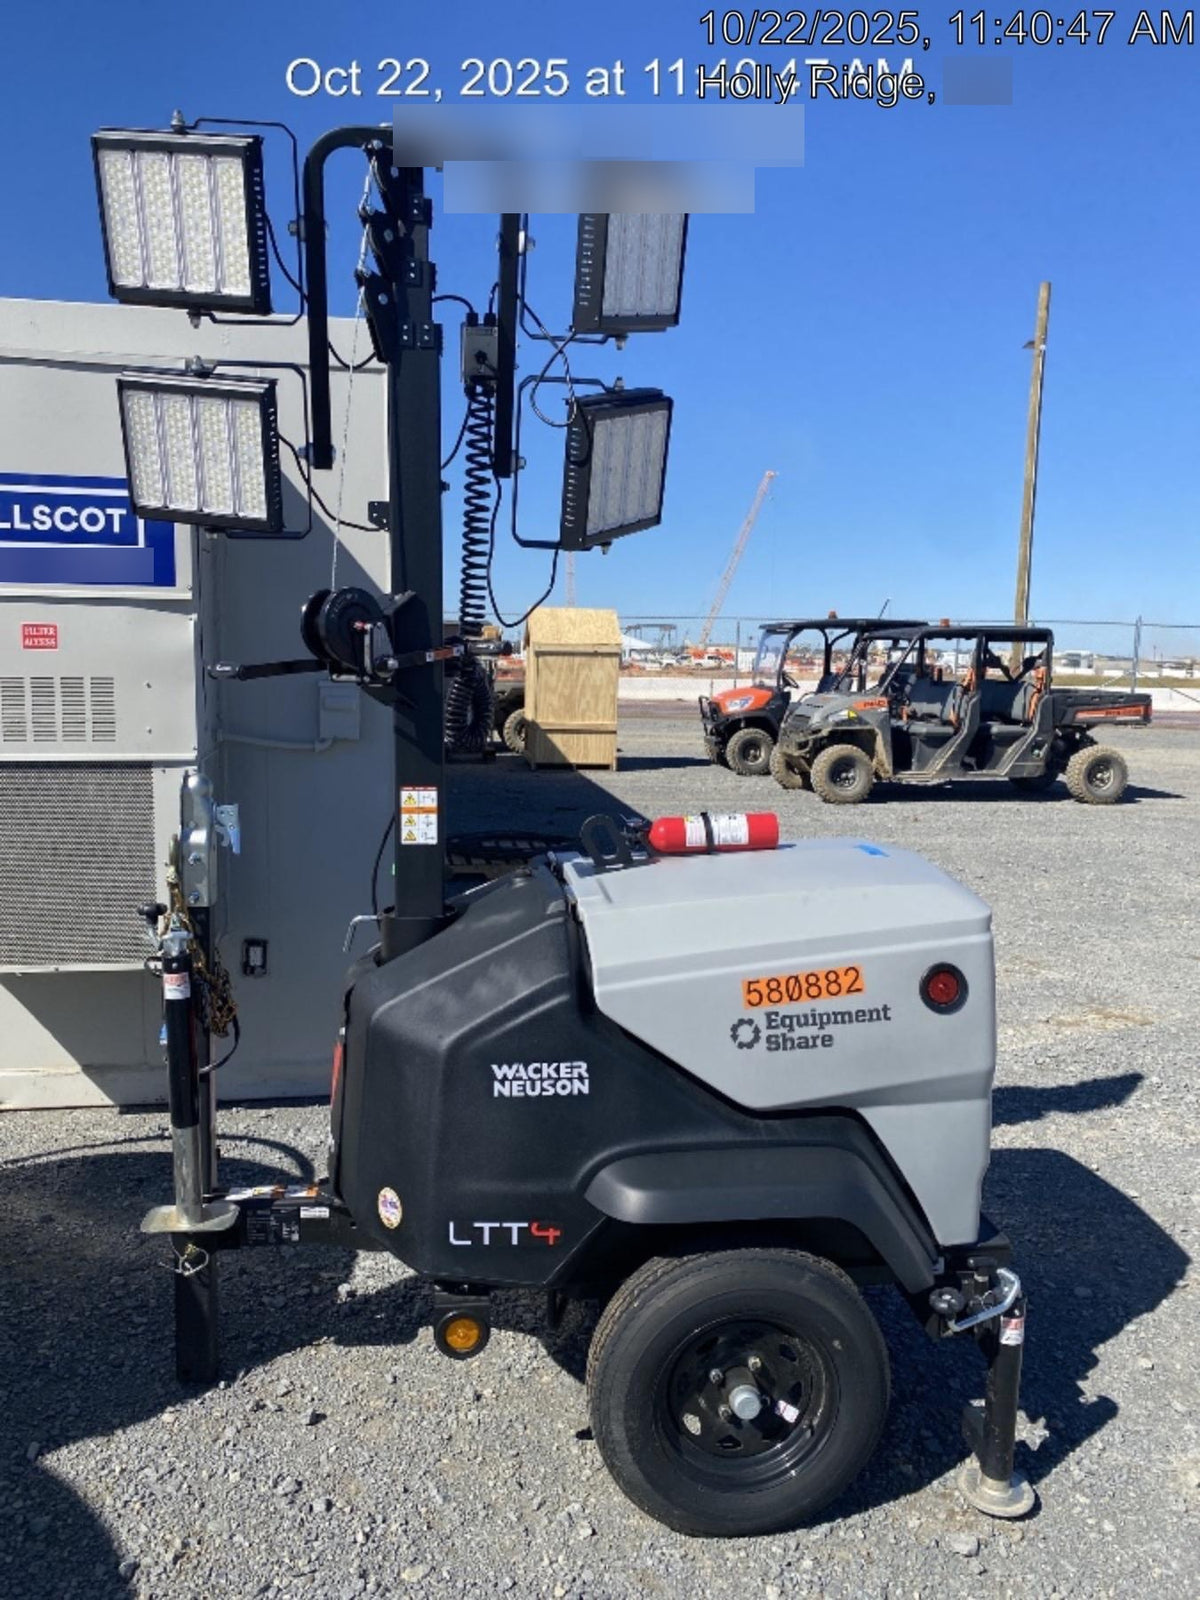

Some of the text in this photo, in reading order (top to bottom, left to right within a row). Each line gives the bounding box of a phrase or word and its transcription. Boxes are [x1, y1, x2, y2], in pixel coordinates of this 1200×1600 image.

[745, 966, 864, 1008] 580882
[765, 1003, 892, 1032] Equipment
[765, 1032, 834, 1052] Share
[490, 1061, 589, 1080] WACKER
[493, 1078, 589, 1098] NEUSON
[449, 1221, 561, 1246] LTT4
